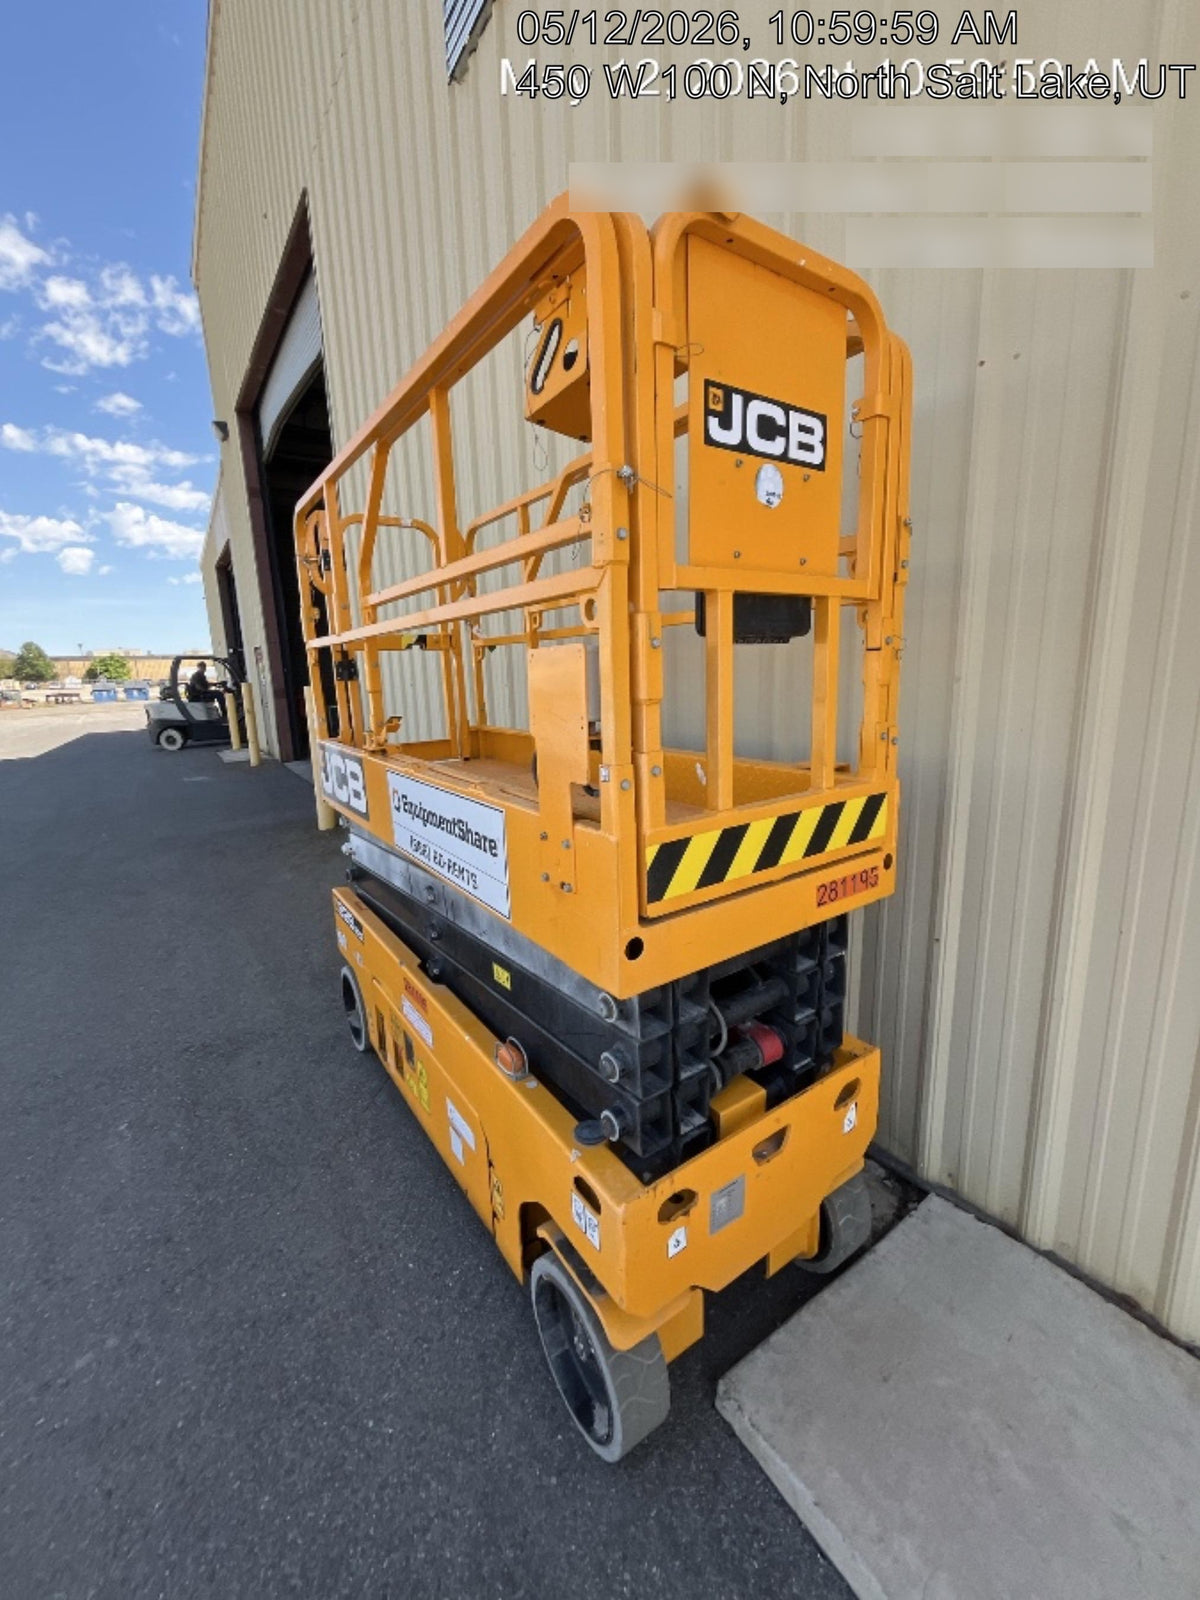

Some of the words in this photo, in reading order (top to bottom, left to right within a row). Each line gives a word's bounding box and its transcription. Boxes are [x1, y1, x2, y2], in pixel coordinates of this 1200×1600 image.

[707, 392, 825, 465] JCB
[321, 751, 367, 813] JCB
[401, 793, 498, 857] EquipmentShare
[817, 866, 879, 907] 281195
